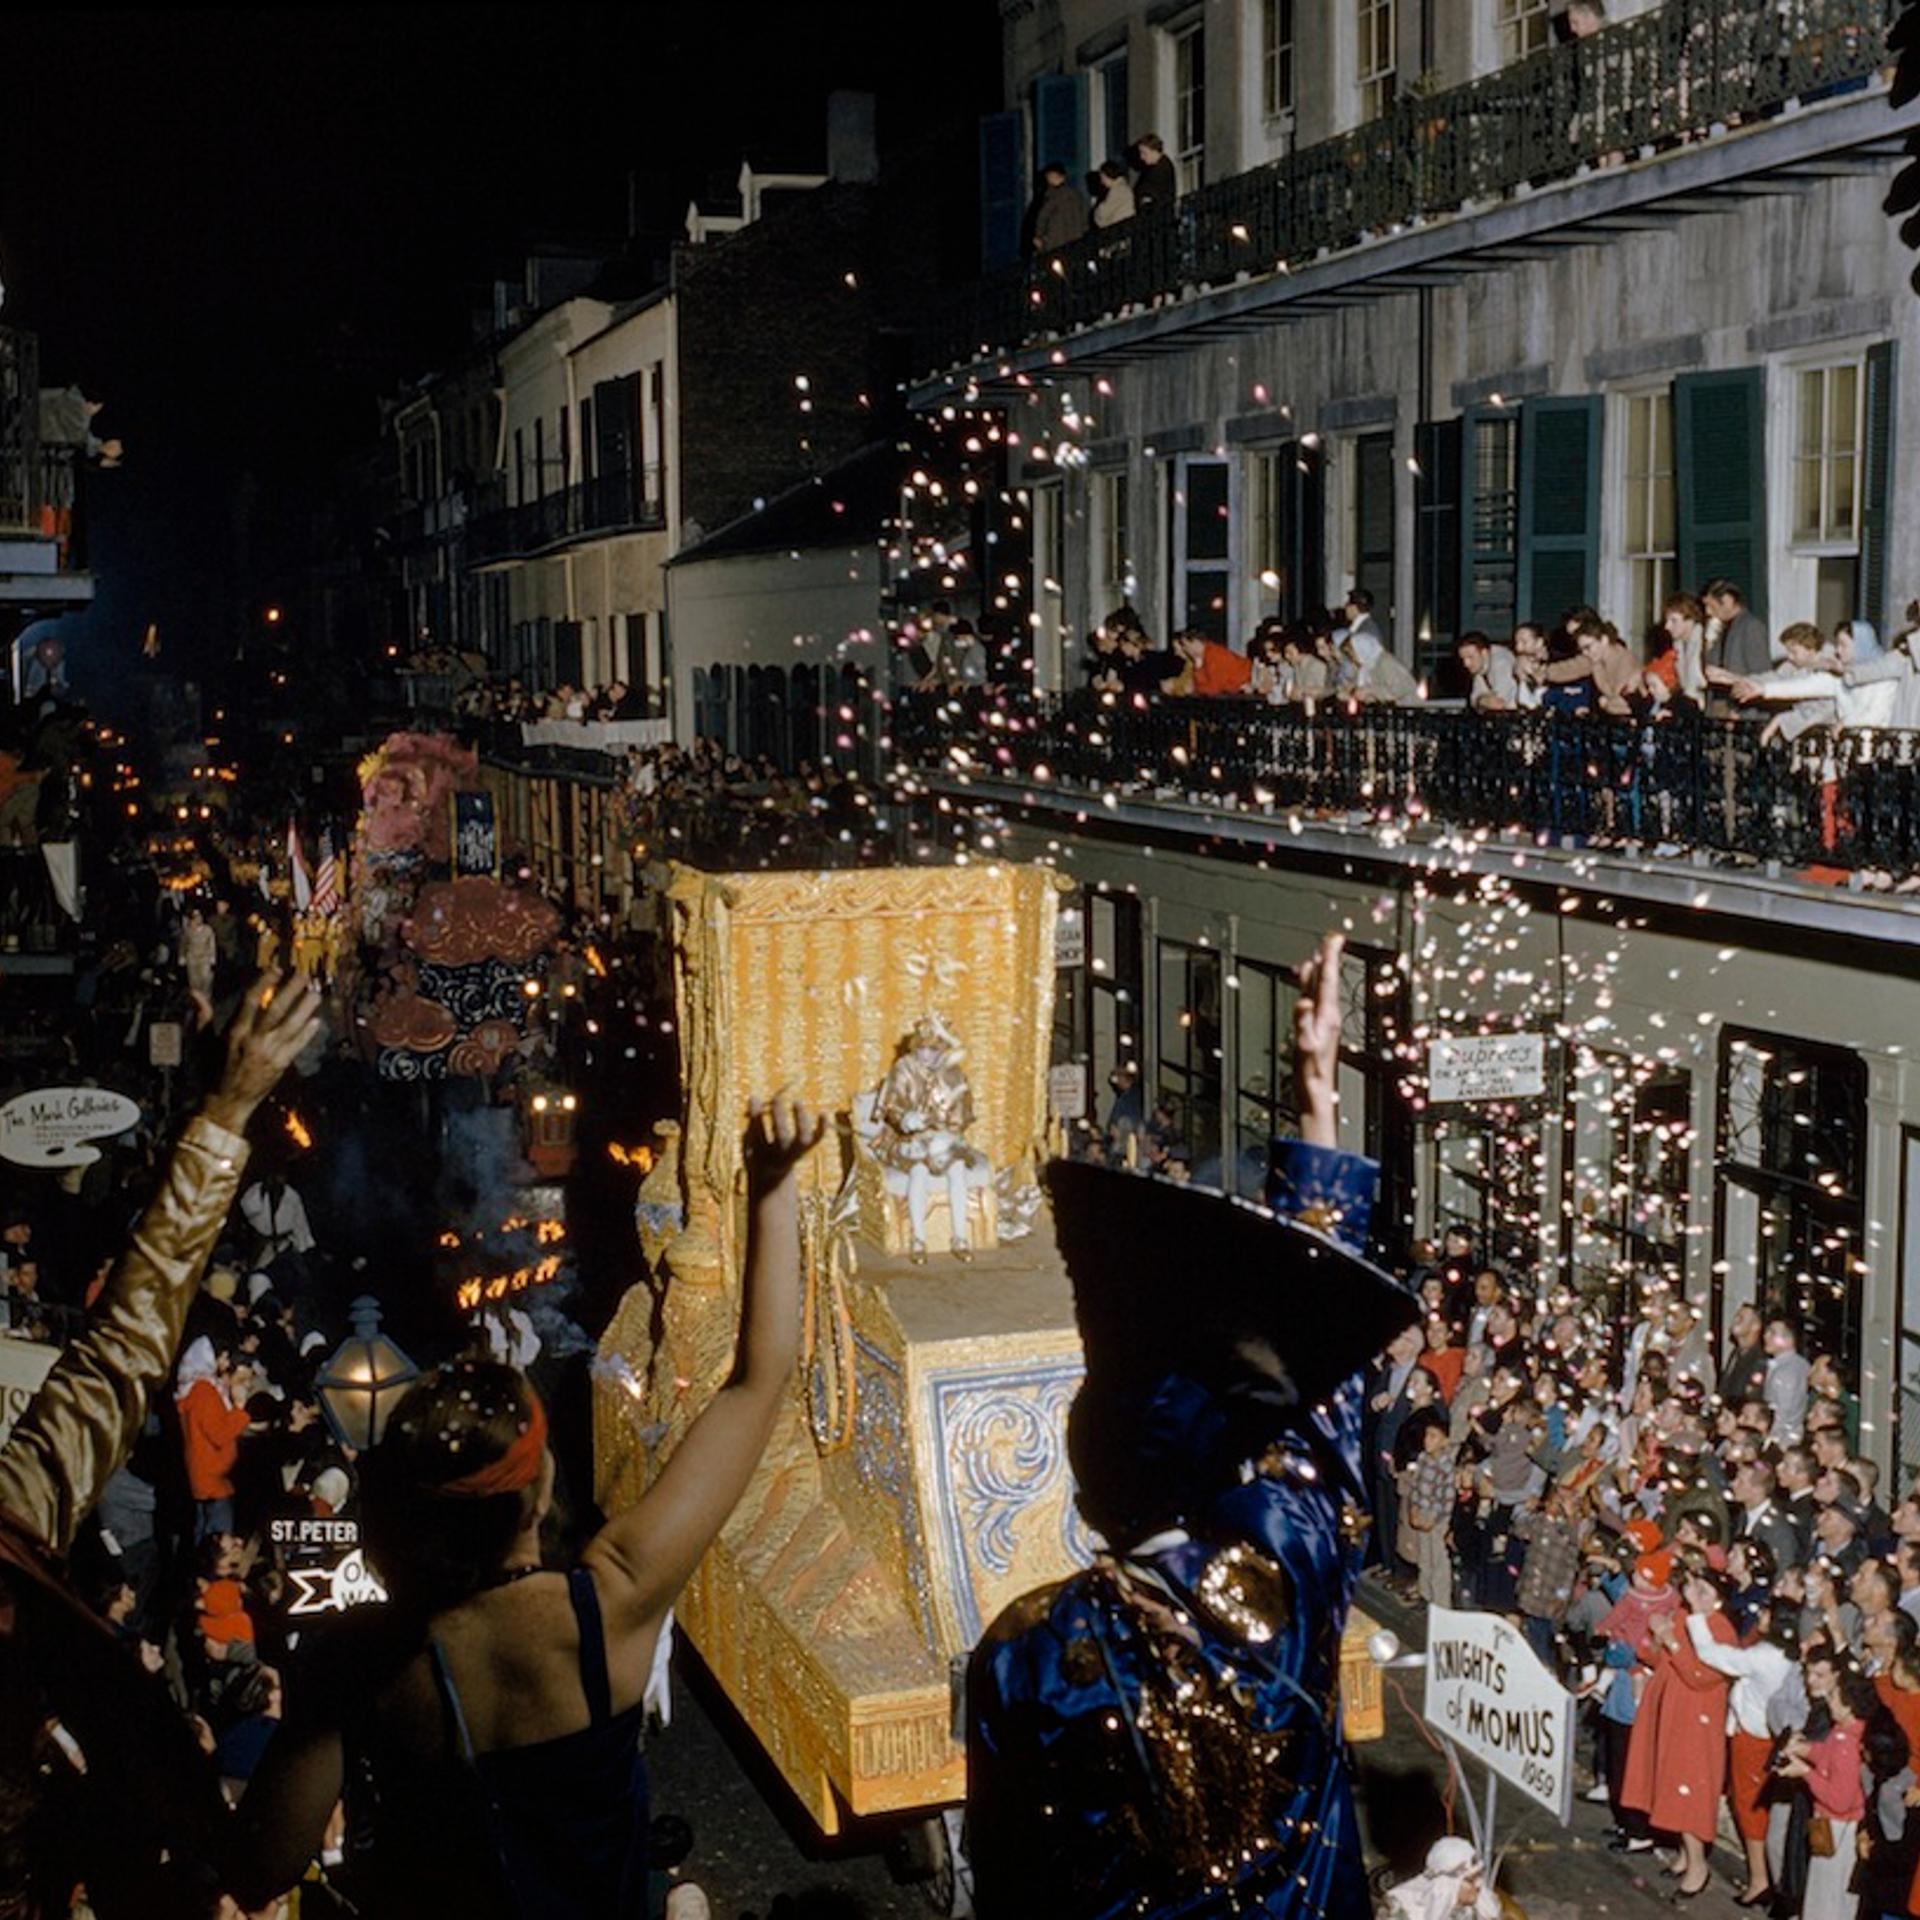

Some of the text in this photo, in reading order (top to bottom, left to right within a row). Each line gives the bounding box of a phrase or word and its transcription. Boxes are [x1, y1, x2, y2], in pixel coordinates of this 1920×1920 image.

[1433, 1642, 1507, 1694] KNIGHTS
[1446, 1684, 1464, 1728] of
[1521, 1758, 1555, 1797] 1959
